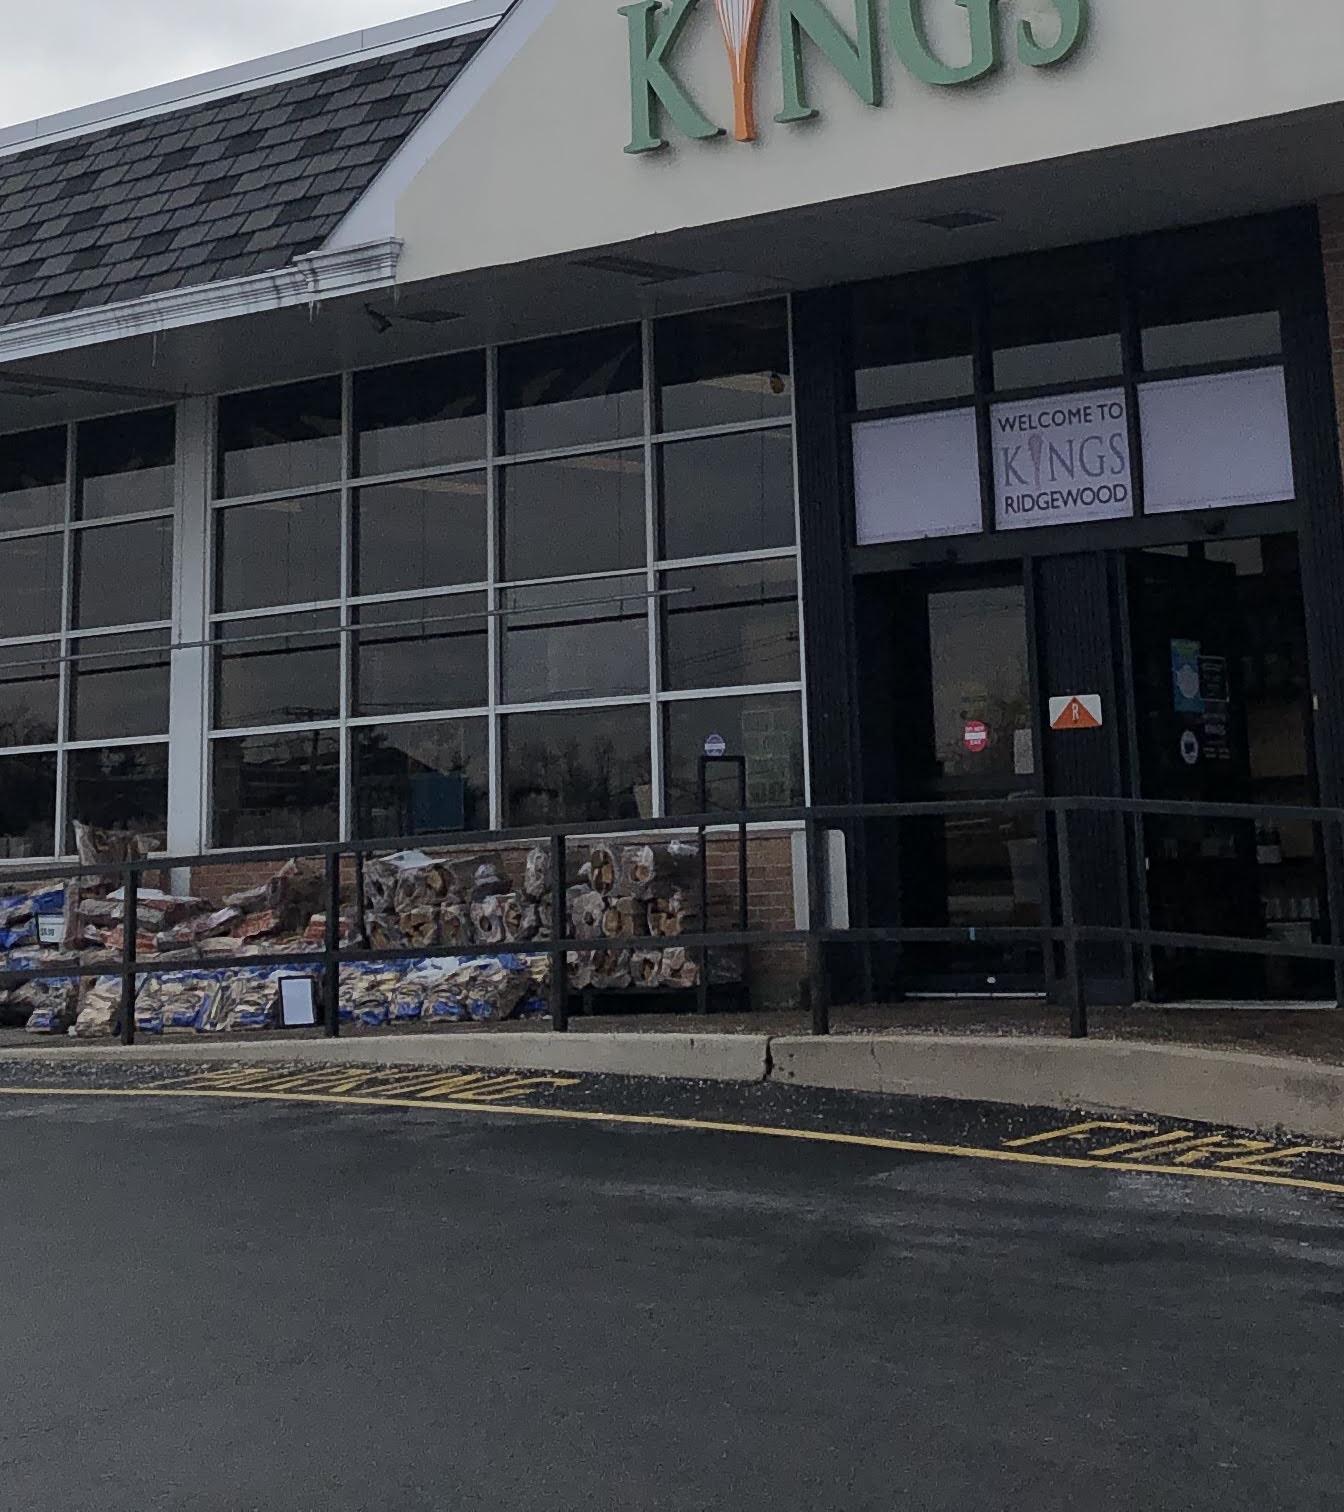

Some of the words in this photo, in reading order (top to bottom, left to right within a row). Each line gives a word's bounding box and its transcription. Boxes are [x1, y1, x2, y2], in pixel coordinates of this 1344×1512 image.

[998, 406, 1093, 432] WELCOME
[1096, 402, 1123, 421] TO
[1002, 433, 1126, 487] KINGS
[1004, 483, 1128, 514] RIDGEWOOD
[1071, 703, 1080, 721] R
